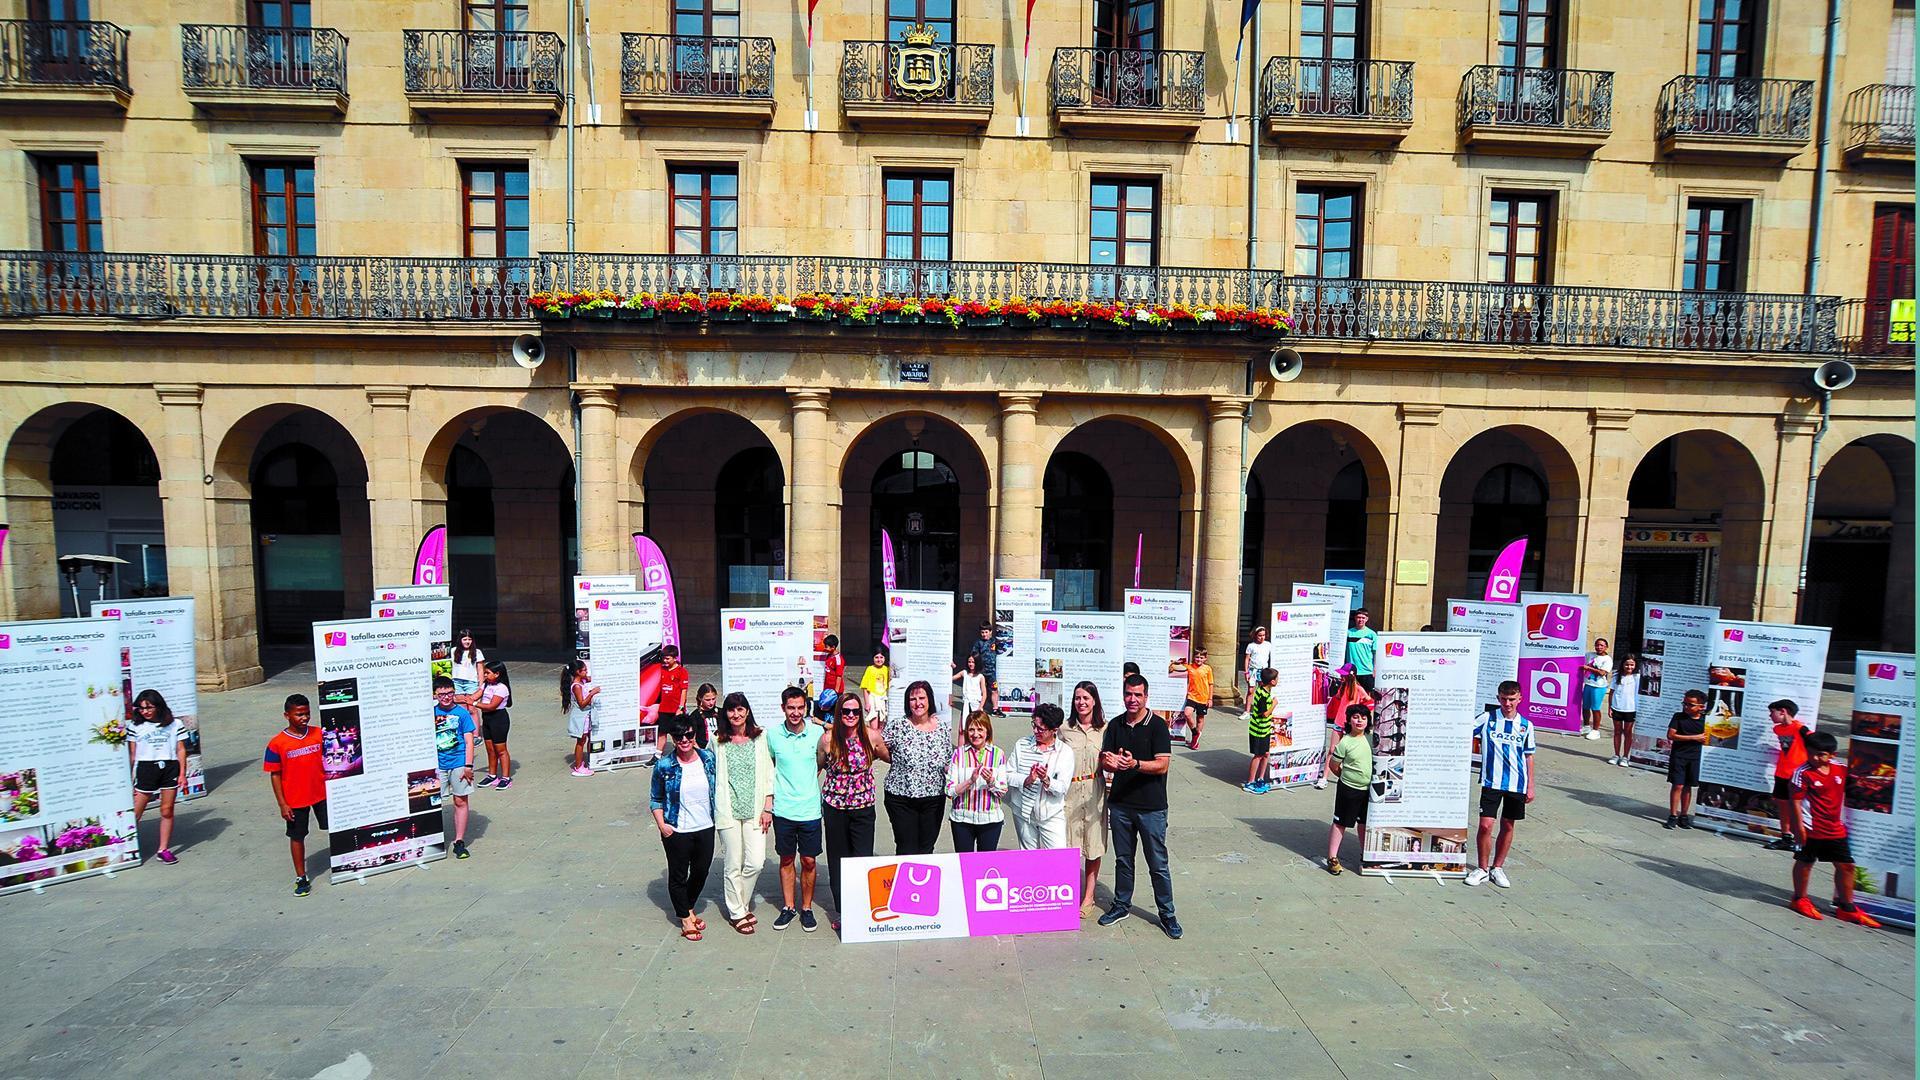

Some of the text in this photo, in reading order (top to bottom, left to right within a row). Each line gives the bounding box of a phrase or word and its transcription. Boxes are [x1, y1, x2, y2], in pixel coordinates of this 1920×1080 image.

[16, 632, 105, 644] tafalla esco.mercio
[351, 628, 420, 641] tafalla esco.mercio
[1040, 645, 1079, 653] FLORISTERÍA
[1408, 645, 1430, 653] tafalla
[324, 657, 424, 673] NAVAR COMUNICACIÓN
[1718, 655, 1775, 666] RESTAURANTE
[1381, 672, 1410, 680] ÓPTICA
[1862, 697, 1910, 708] ASADOR
[868, 922, 942, 933] tafalla esco.mercio
